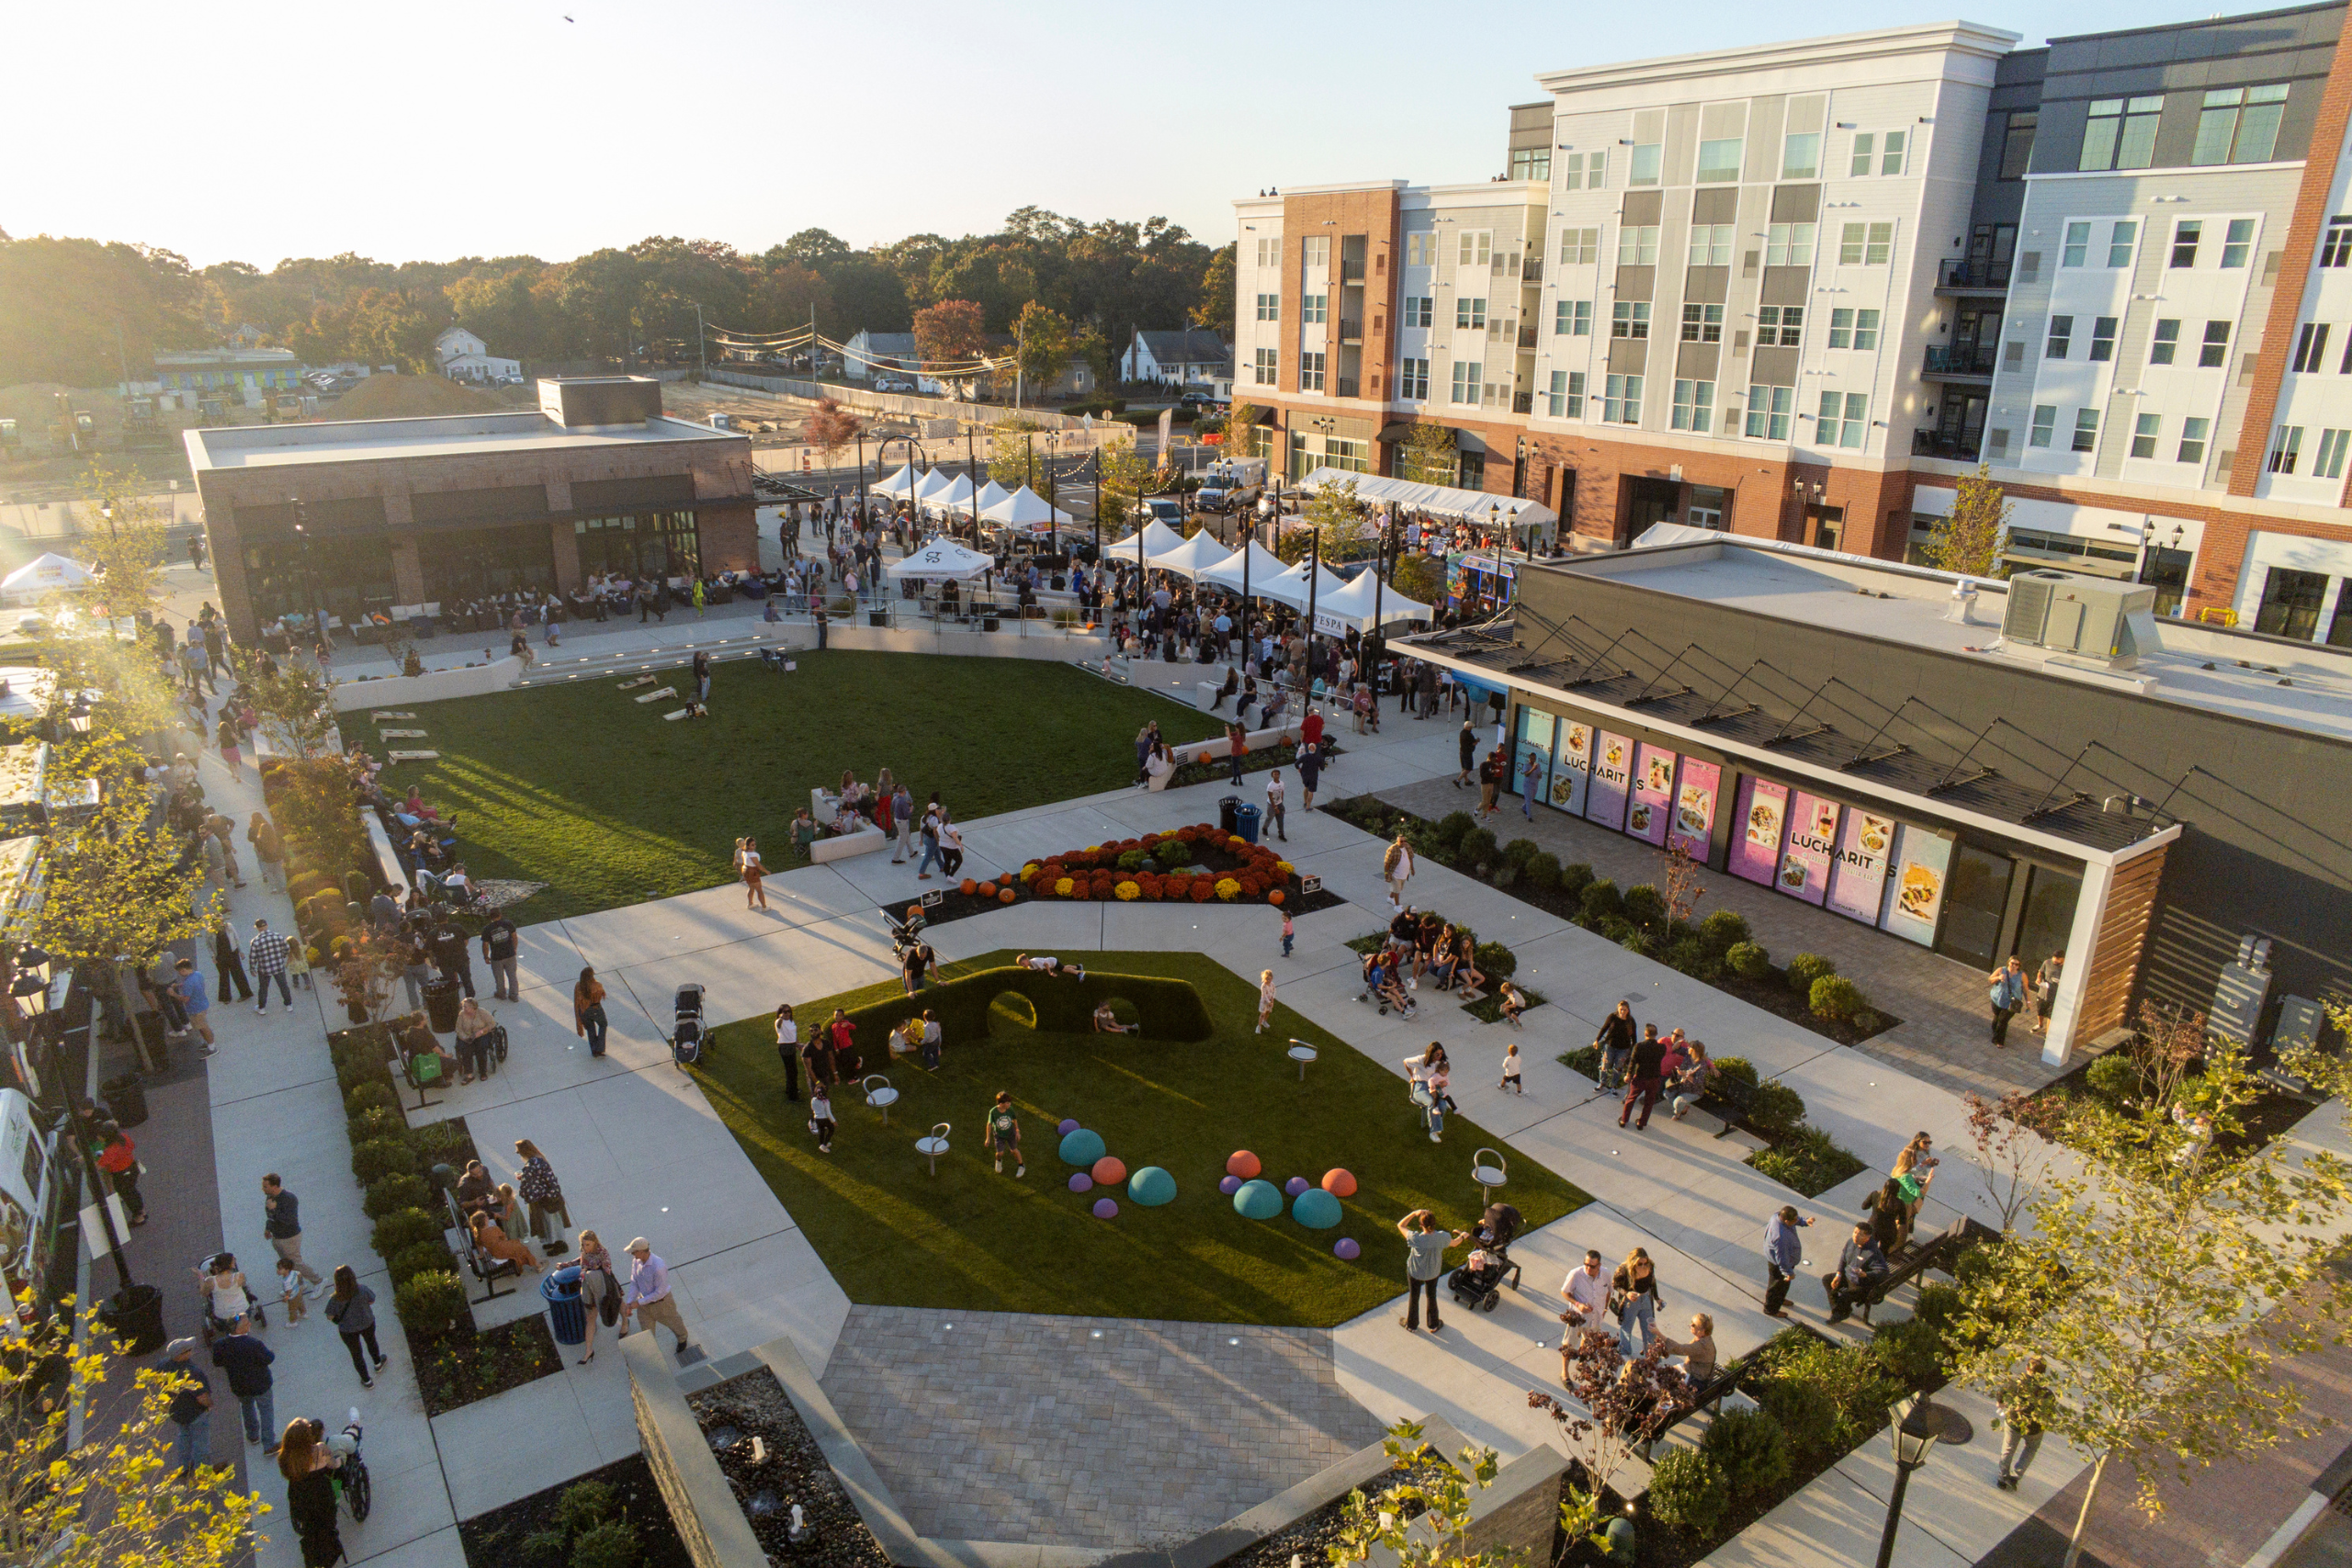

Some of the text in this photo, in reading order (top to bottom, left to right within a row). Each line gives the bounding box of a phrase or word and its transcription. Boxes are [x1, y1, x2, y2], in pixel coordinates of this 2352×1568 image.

[1071, 438, 1097, 446] TRITEC
[1314, 614, 1341, 630] VESPA
[1517, 737, 1552, 752] LUCHARITS
